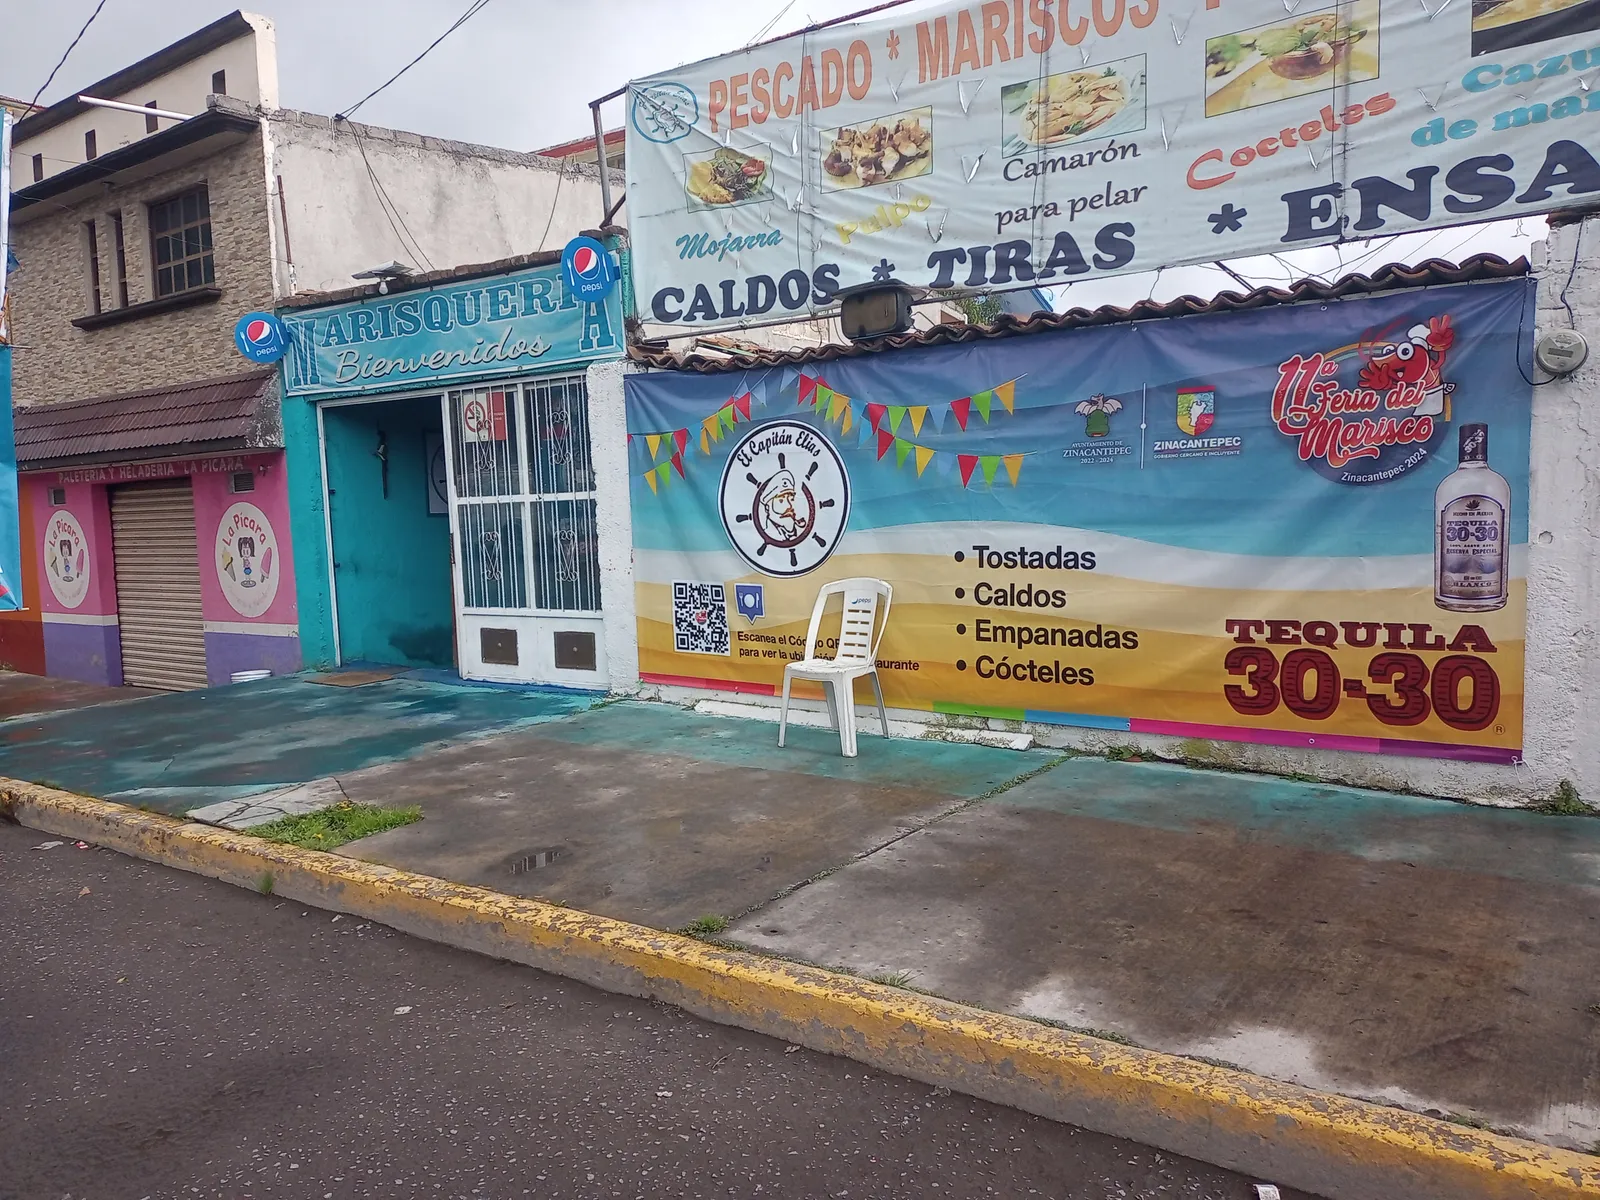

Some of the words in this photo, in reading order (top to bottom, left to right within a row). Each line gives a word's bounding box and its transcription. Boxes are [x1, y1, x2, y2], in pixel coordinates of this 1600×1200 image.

[1461, 46, 1600, 93] Cazu
[708, 39, 872, 134] PESCADO
[1186, 91, 1397, 191] Cocteles
[1410, 117, 1477, 148] de
[1002, 138, 1141, 182] Camarón
[834, 193, 932, 246] Pulpo
[994, 201, 1062, 235] para
[1067, 180, 1148, 222] pelar
[650, 262, 840, 323] CALDOS
[926, 221, 1136, 290] TIRAS
[1281, 139, 1600, 243] ENSA
[675, 226, 784, 267] Mojarra
[581, 281, 603, 294] pepsi
[256, 345, 278, 358] pepsi
[335, 326, 553, 384] Bienvenidos
[1304, 381, 1380, 418] Feria
[1385, 379, 1428, 411] del
[737, 451, 753, 468] El
[749, 429, 793, 456] Capitán
[1063, 446, 1132, 457] ZINACANTEPEC
[1154, 437, 1242, 451] ZINACANTEPEC
[1278, 415, 1434, 468] Marisco
[58, 469, 106, 484] PALETERIA
[107, 468, 115, 480] Y
[119, 463, 176, 479] HELADERIA
[1341, 464, 1405, 483] Zinacantepec
[1404, 447, 1428, 468] 2024
[48, 530, 58, 547] La
[222, 526, 235, 547] La
[1446, 527, 1498, 541] 30-30
[972, 545, 1097, 570] Tostadas
[974, 582, 1067, 609] Caldos
[737, 631, 777, 645] Escanea
[778, 633, 787, 645] el
[788, 635, 824, 650] Cóo
[975, 619, 1139, 650] Empanadas
[1225, 619, 1498, 653] TEQUILA
[739, 647, 760, 659] para
[762, 649, 777, 659] ver
[779, 648, 789, 659] la
[789, 651, 835, 662] ubición
[975, 654, 1095, 686] Cócteles
[1223, 646, 1501, 732] 30-30
